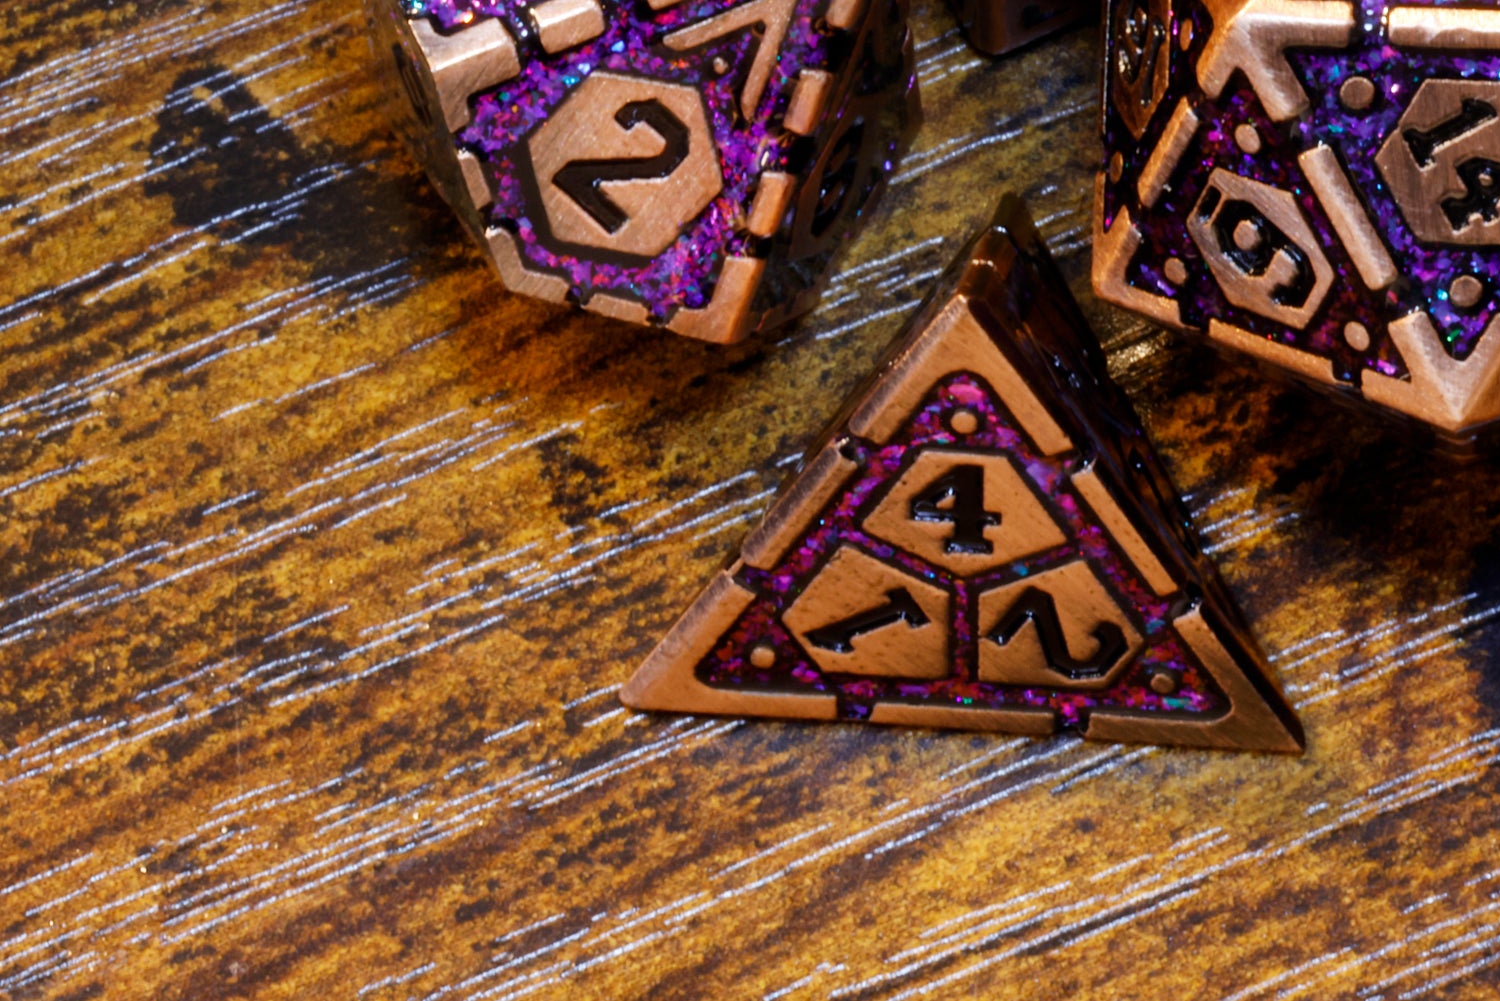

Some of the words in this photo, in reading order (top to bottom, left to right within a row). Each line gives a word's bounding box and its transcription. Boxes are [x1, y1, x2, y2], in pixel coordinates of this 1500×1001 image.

[552, 98, 690, 234] 2
[909, 464, 1002, 555] 4
[802, 587, 931, 652] 1
[988, 586, 1128, 680] 2
